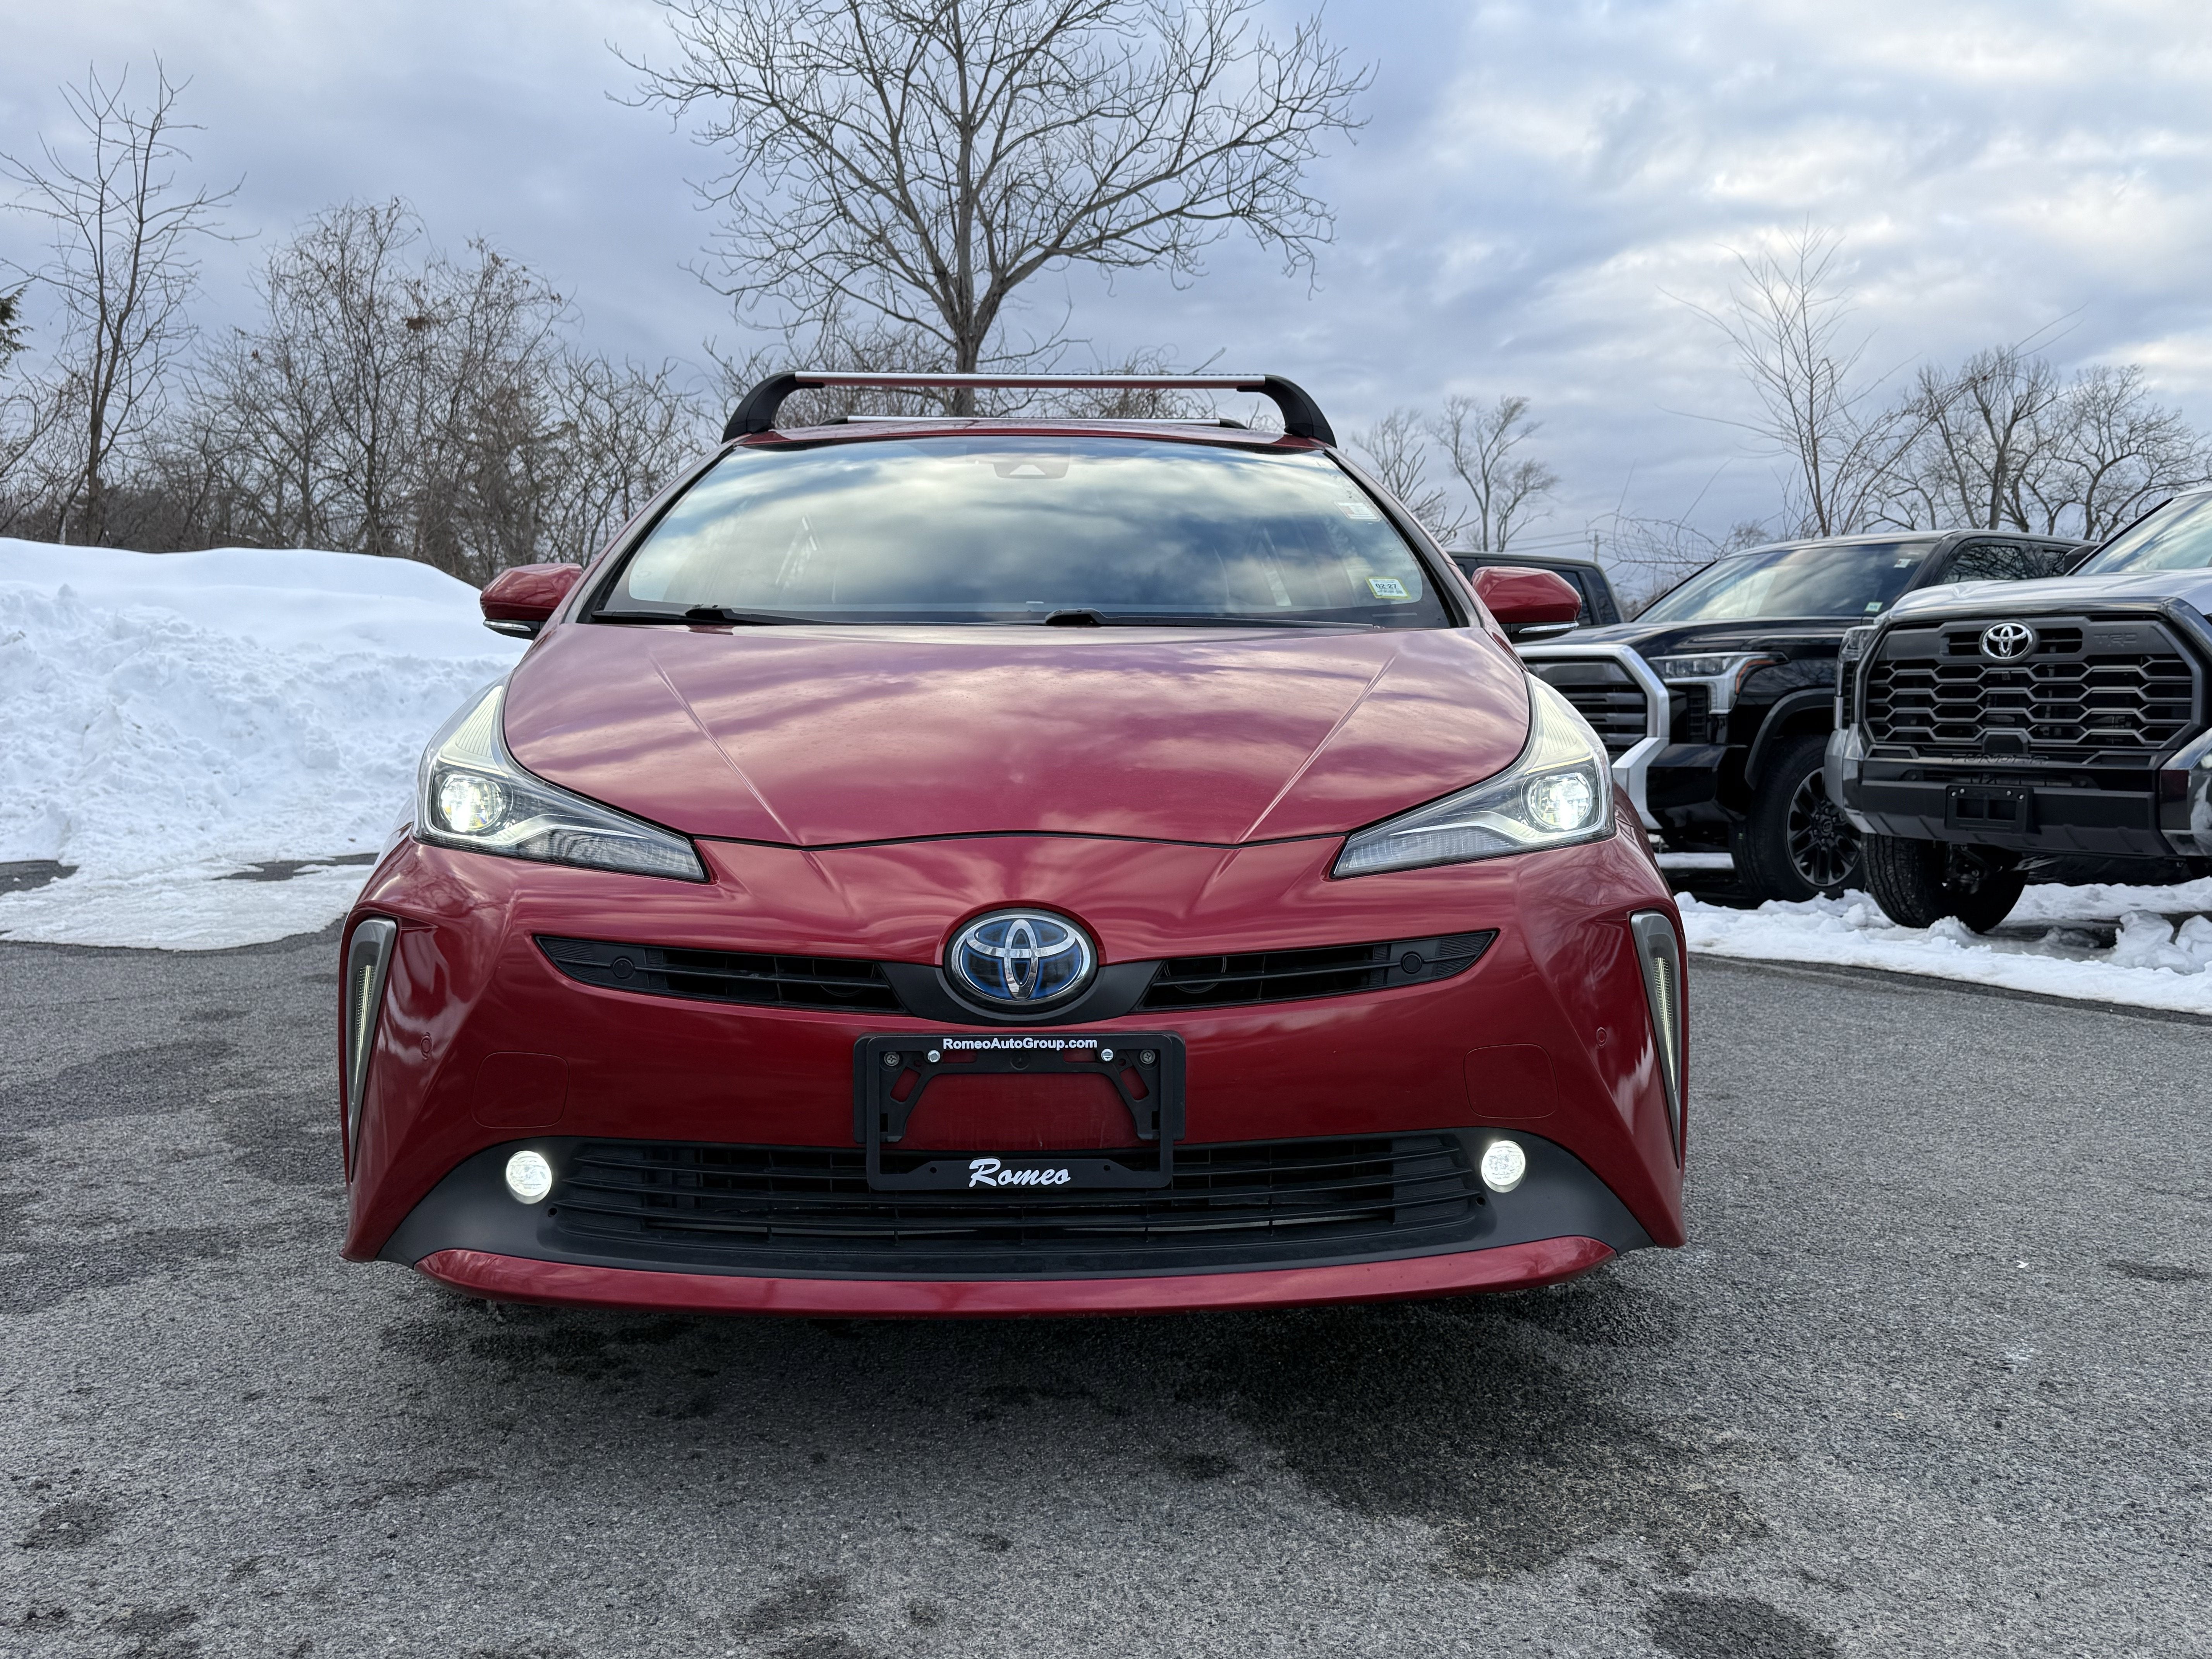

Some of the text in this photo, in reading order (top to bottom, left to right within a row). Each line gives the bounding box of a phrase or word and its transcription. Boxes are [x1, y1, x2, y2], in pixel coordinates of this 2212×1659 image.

[2094, 633, 2137, 646] TRD
[943, 1038, 1097, 1050] RomeoAutoGroup.com
[969, 1158, 1071, 1187] Romeo
